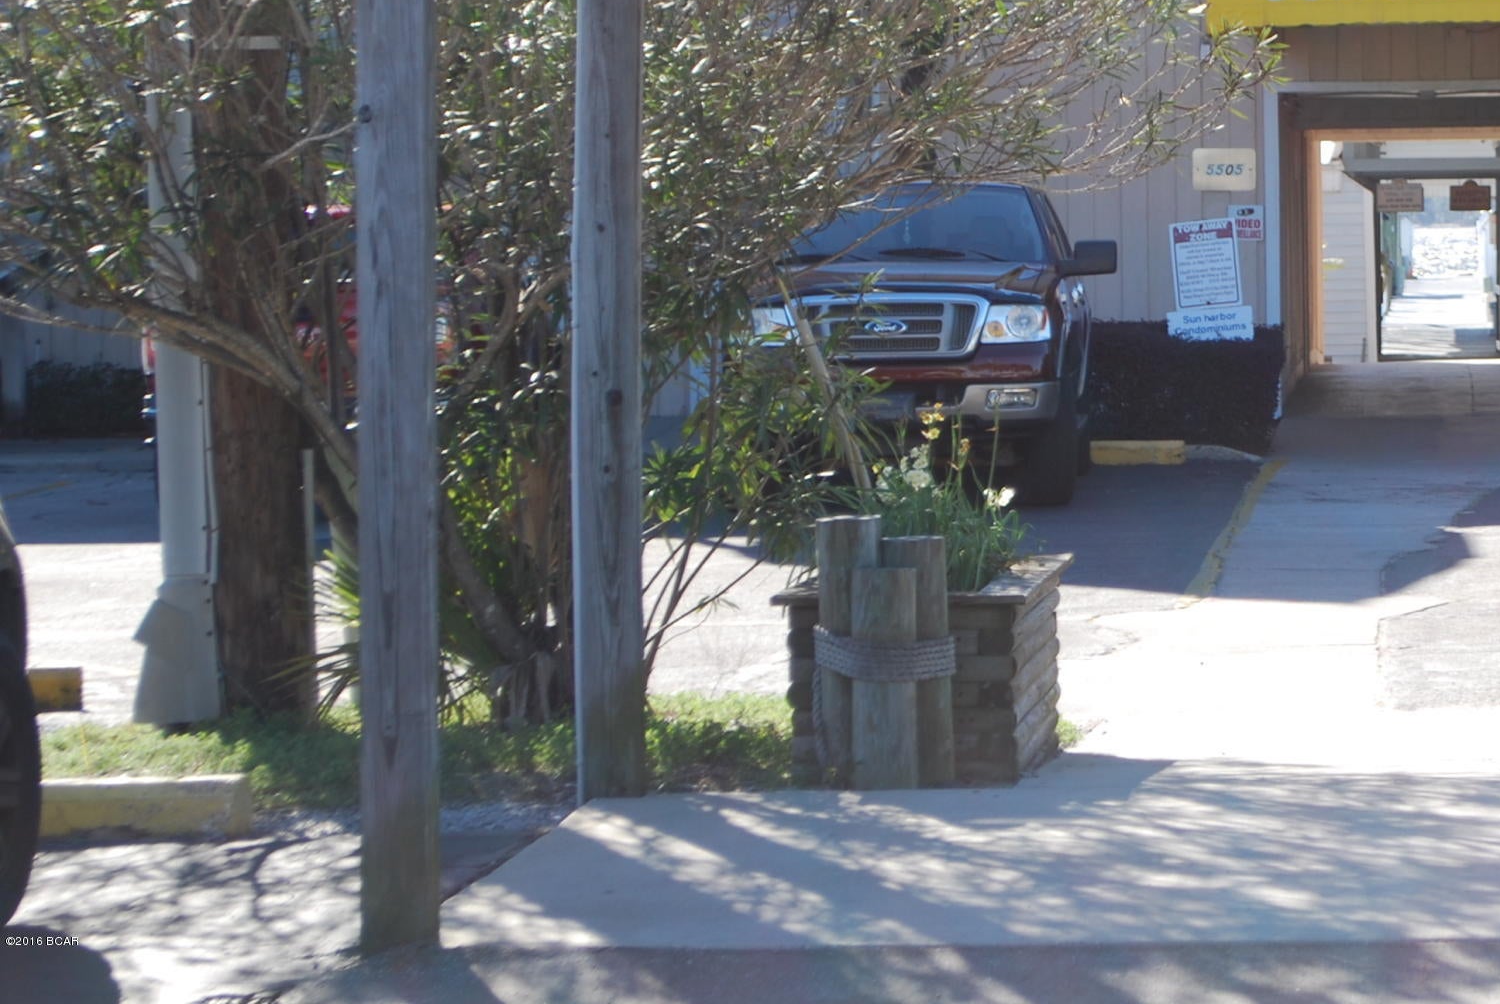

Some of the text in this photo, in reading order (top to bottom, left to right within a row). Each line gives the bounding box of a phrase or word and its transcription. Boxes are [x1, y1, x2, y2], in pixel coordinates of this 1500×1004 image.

[1206, 163, 1244, 176] 5505
[1183, 312, 1236, 324] Sun harbor
[1175, 323, 1246, 336] Condominiums
